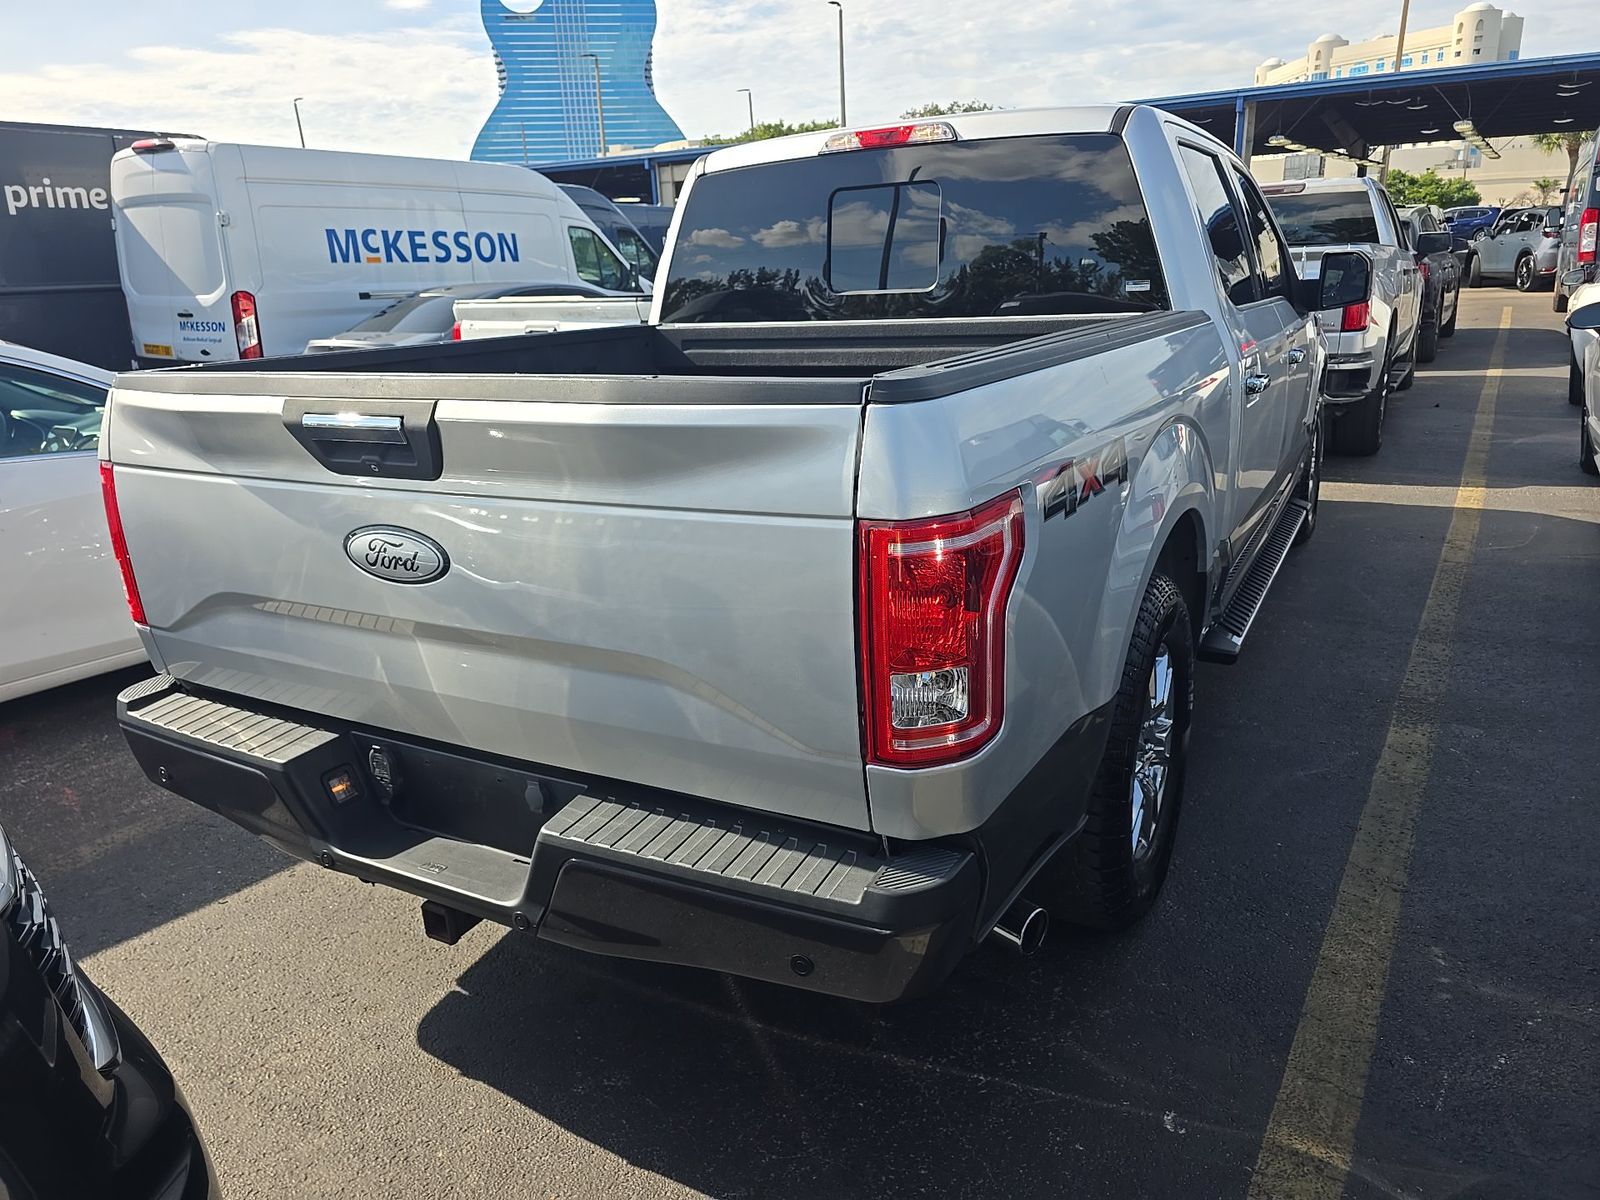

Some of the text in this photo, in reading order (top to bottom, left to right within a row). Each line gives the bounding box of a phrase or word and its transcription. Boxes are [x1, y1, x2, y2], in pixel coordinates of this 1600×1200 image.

[3, 177, 109, 216] prime
[1043, 436, 1128, 523] 4x4
[365, 538, 420, 573] Ford
